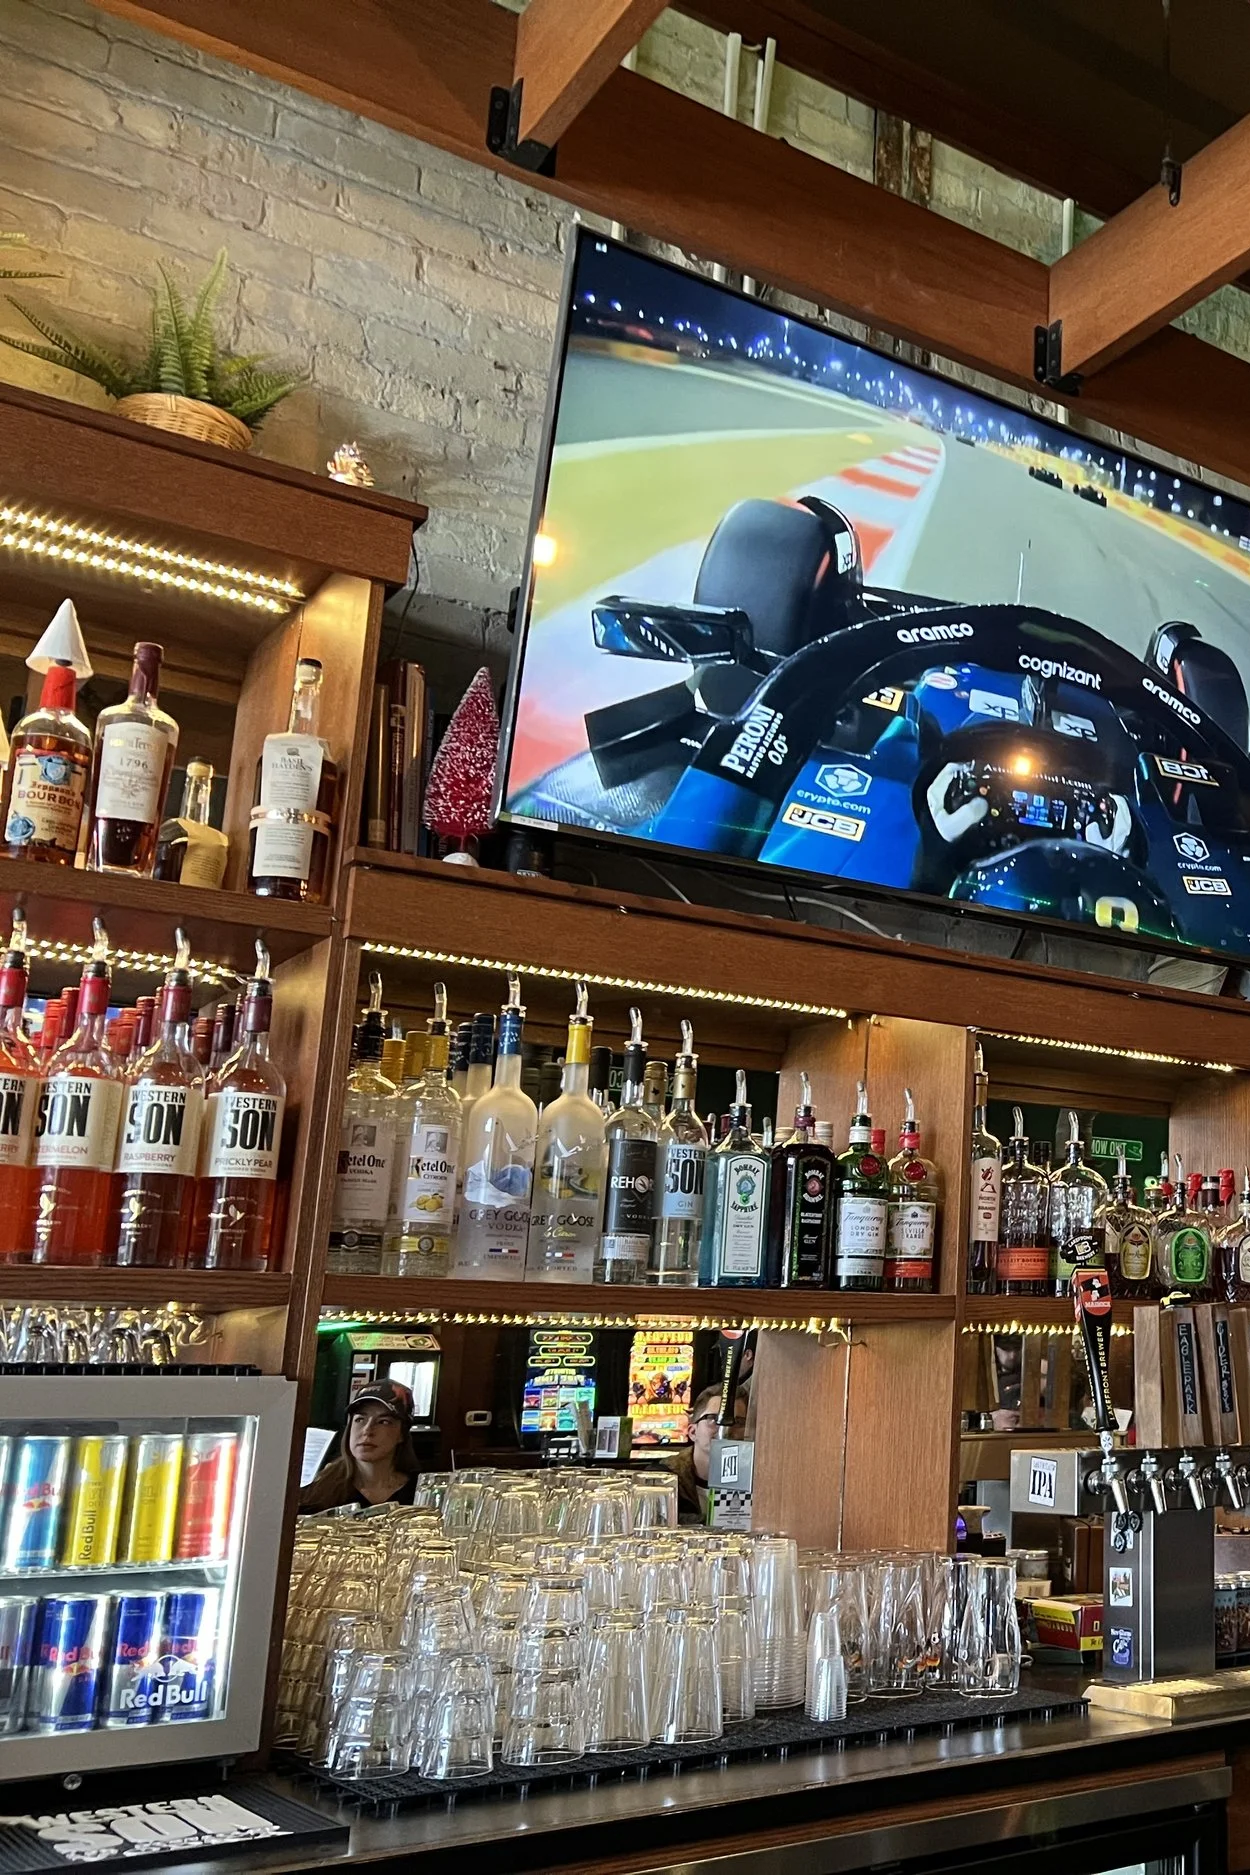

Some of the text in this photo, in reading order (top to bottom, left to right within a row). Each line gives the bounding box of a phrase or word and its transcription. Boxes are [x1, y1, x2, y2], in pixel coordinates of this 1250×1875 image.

[896, 622, 974, 643] aramco
[1018, 653, 1102, 691] cognizant
[1141, 677, 1201, 725] aramco
[720, 702, 776, 775] PERONI
[119, 757, 149, 770] 1796
[17, 789, 82, 811] BOURBON
[795, 787, 872, 815] crypto.com
[788, 805, 860, 837] JCB
[1177, 861, 1222, 872] crypto.com
[1187, 877, 1228, 893] JCB
[131, 1089, 187, 1104] WESTERN
[36, 1095, 92, 1138] SON
[126, 1101, 186, 1146] SON
[221, 1109, 277, 1152] SON
[123, 1151, 177, 1163] RASPBERRY
[214, 1156, 273, 1169] PRICKLY PEAR
[665, 1158, 705, 1195] SON
[733, 1163, 760, 1176] BOMBAY
[804, 1169, 825, 1179] BOMBAY
[677, 1200, 693, 1208] GIN
[730, 1200, 759, 1213] SAPPHIRE
[469, 1208, 502, 1221] GREY
[556, 1213, 595, 1228] GOOSE
[843, 1211, 884, 1224] Tanqueray
[488, 1222, 525, 1232] VODKA
[1067, 1235, 1093, 1248] LAKEFRONT
[1076, 1250, 1096, 1262] BREWERY
[1216, 1321, 1229, 1376] CIDER
[1096, 1325, 1115, 1421] LAKEFRONT BREWERY
[1030, 1468, 1054, 1499] IPA
[119, 1680, 208, 1710] Red Bull
